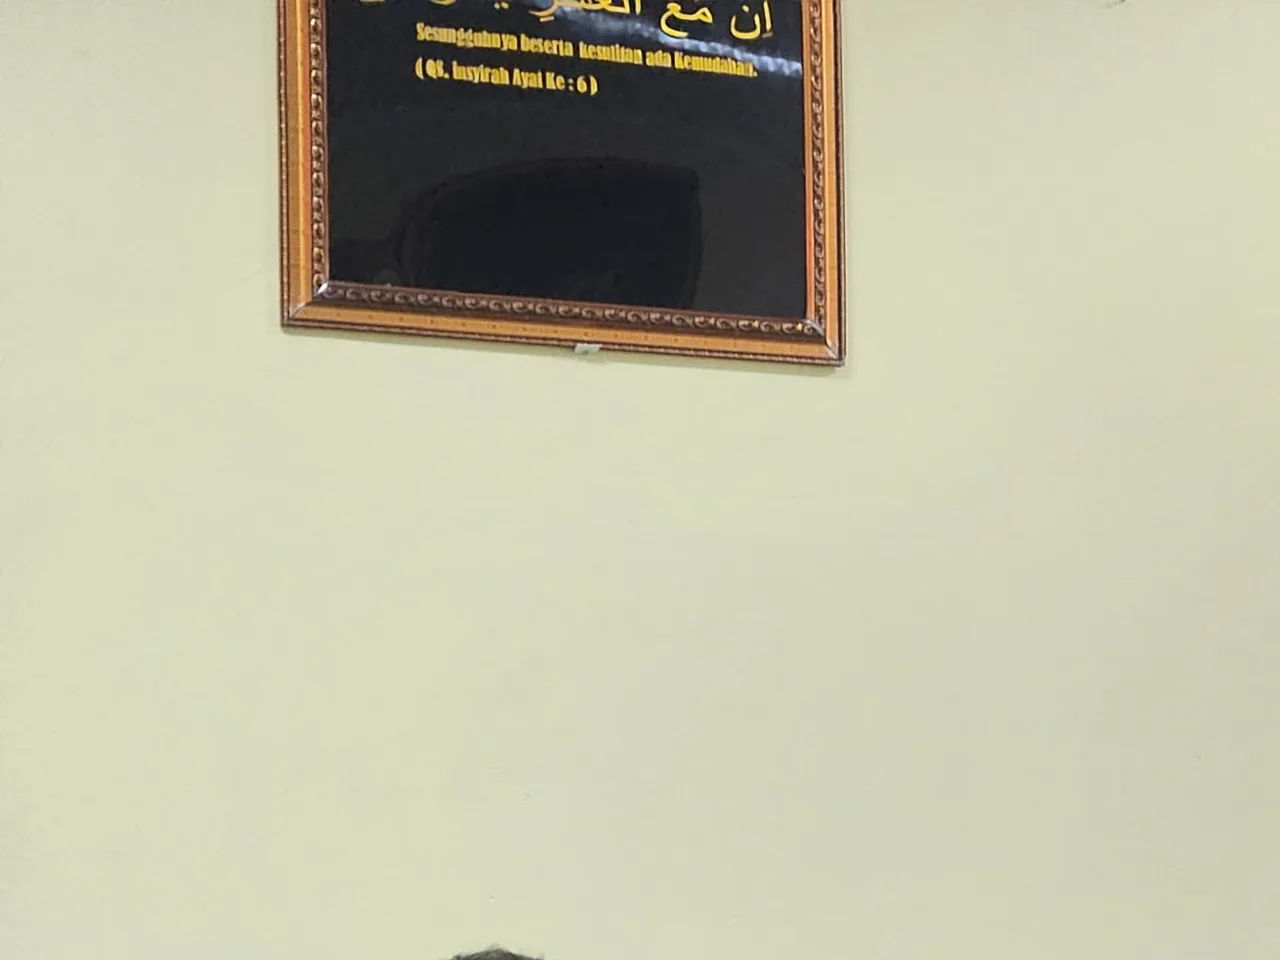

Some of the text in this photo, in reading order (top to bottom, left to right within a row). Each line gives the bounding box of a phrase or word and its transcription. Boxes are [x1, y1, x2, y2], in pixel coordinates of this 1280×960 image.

[416, 22, 758, 78] Sesungguhnya beserta kesulitan ada Kemudahan.
[512, 68, 544, 89] Ayat
[545, 72, 566, 90] Ke
